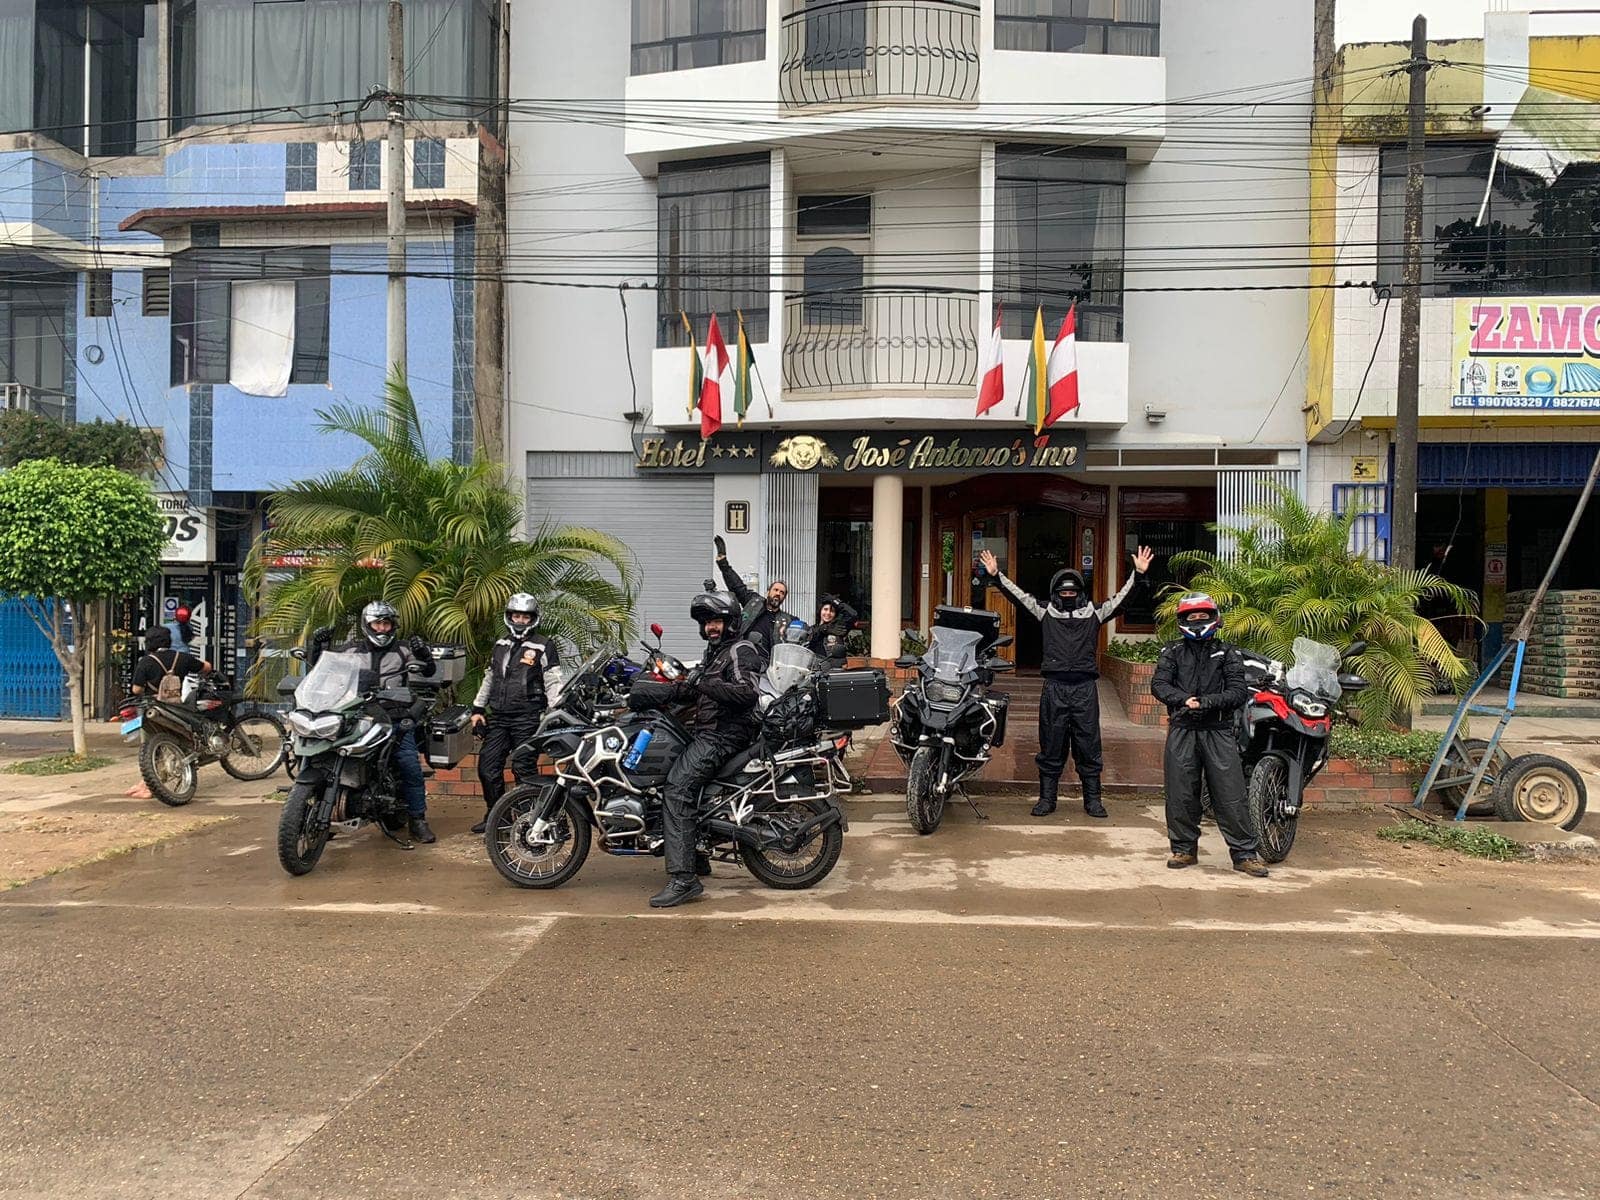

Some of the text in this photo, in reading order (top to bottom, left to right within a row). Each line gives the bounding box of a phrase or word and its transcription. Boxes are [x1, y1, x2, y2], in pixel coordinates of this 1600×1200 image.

[635, 434, 1078, 471] Hotel José Antonio's Inn
[729, 509, 745, 530] H
